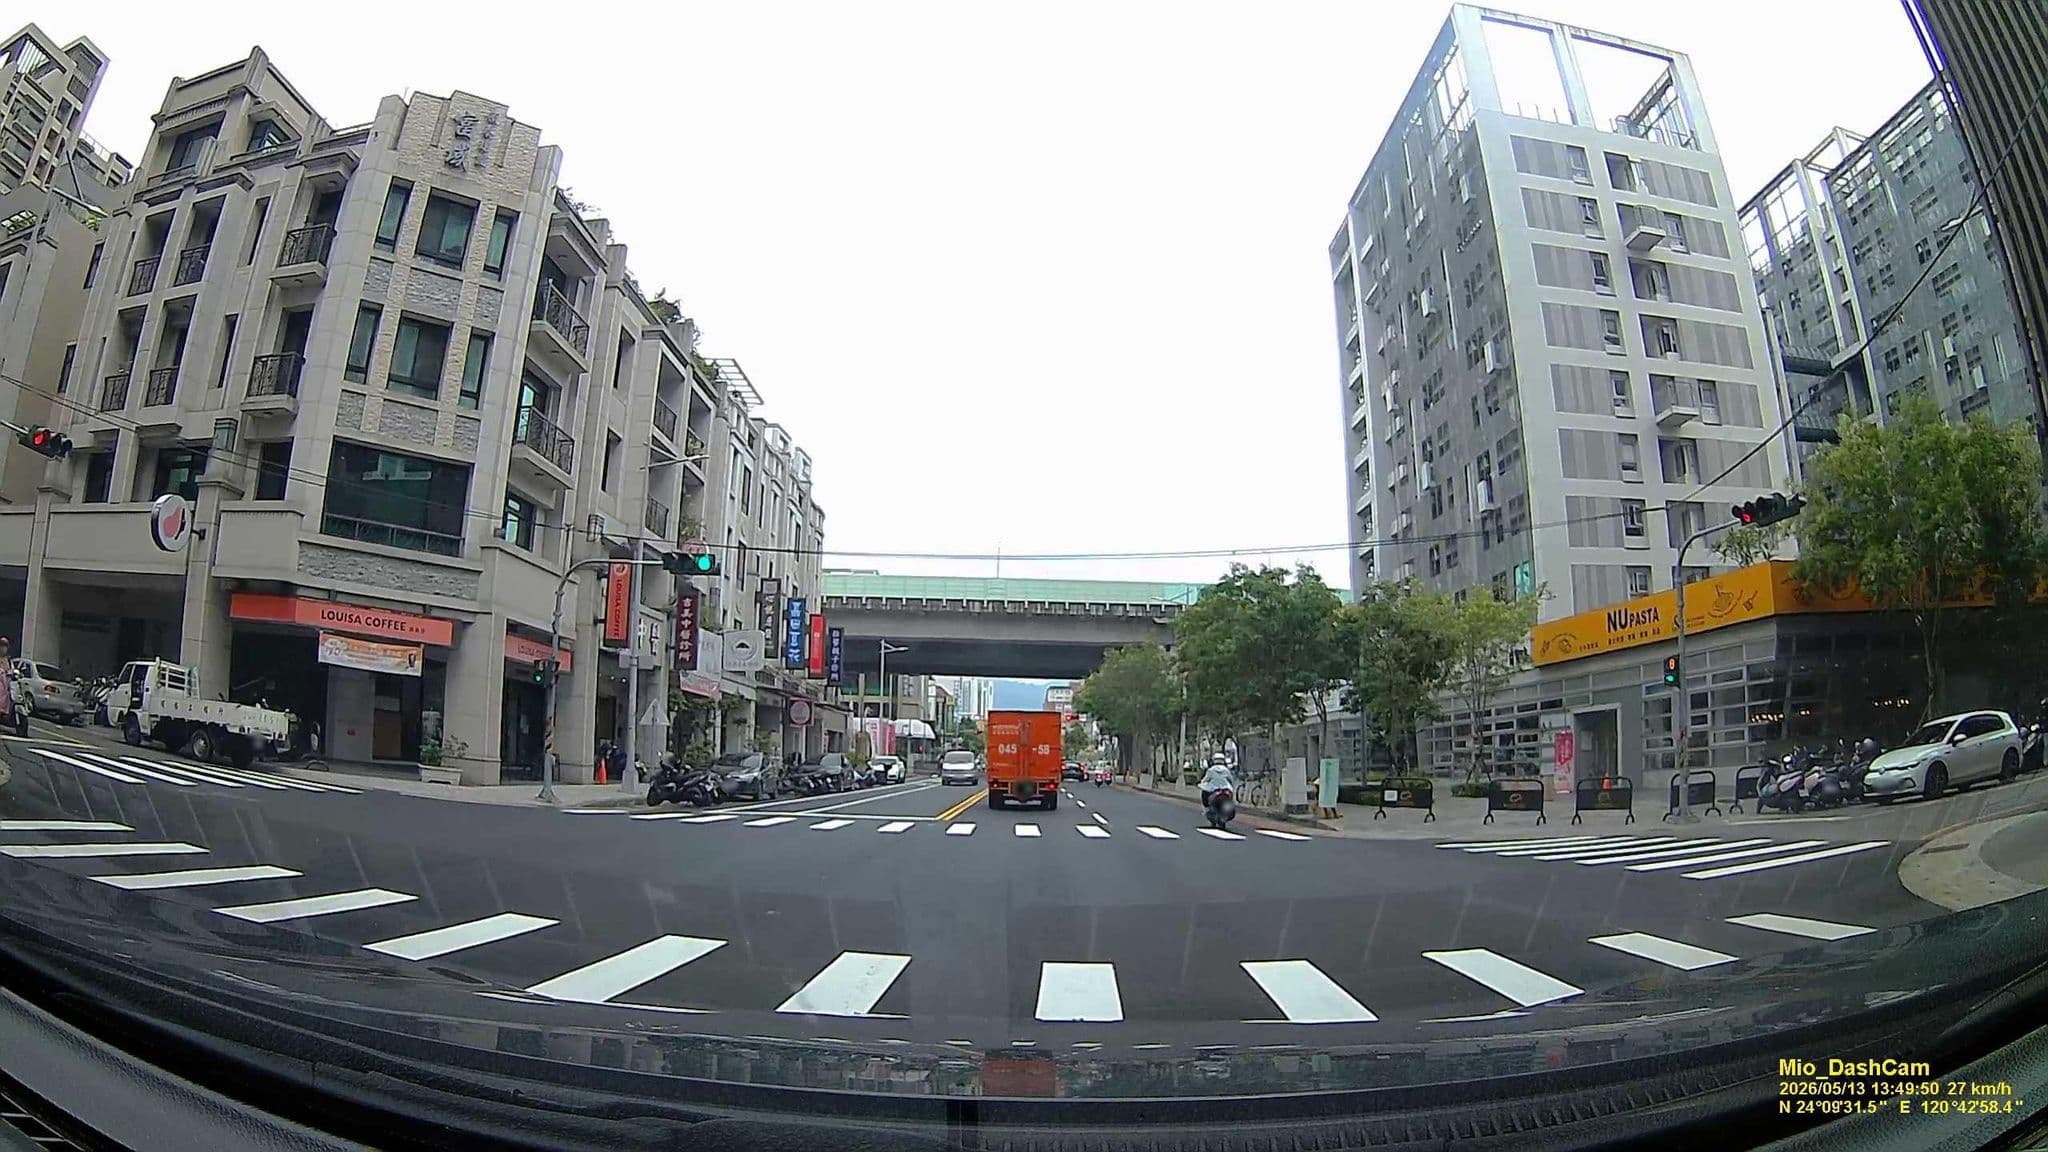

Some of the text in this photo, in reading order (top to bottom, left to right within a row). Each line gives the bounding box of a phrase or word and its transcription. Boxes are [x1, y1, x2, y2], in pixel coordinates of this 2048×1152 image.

[321, 608, 362, 625] LOUISA
[364, 616, 407, 632] COFFEE
[998, 743, 1018, 755] 045
